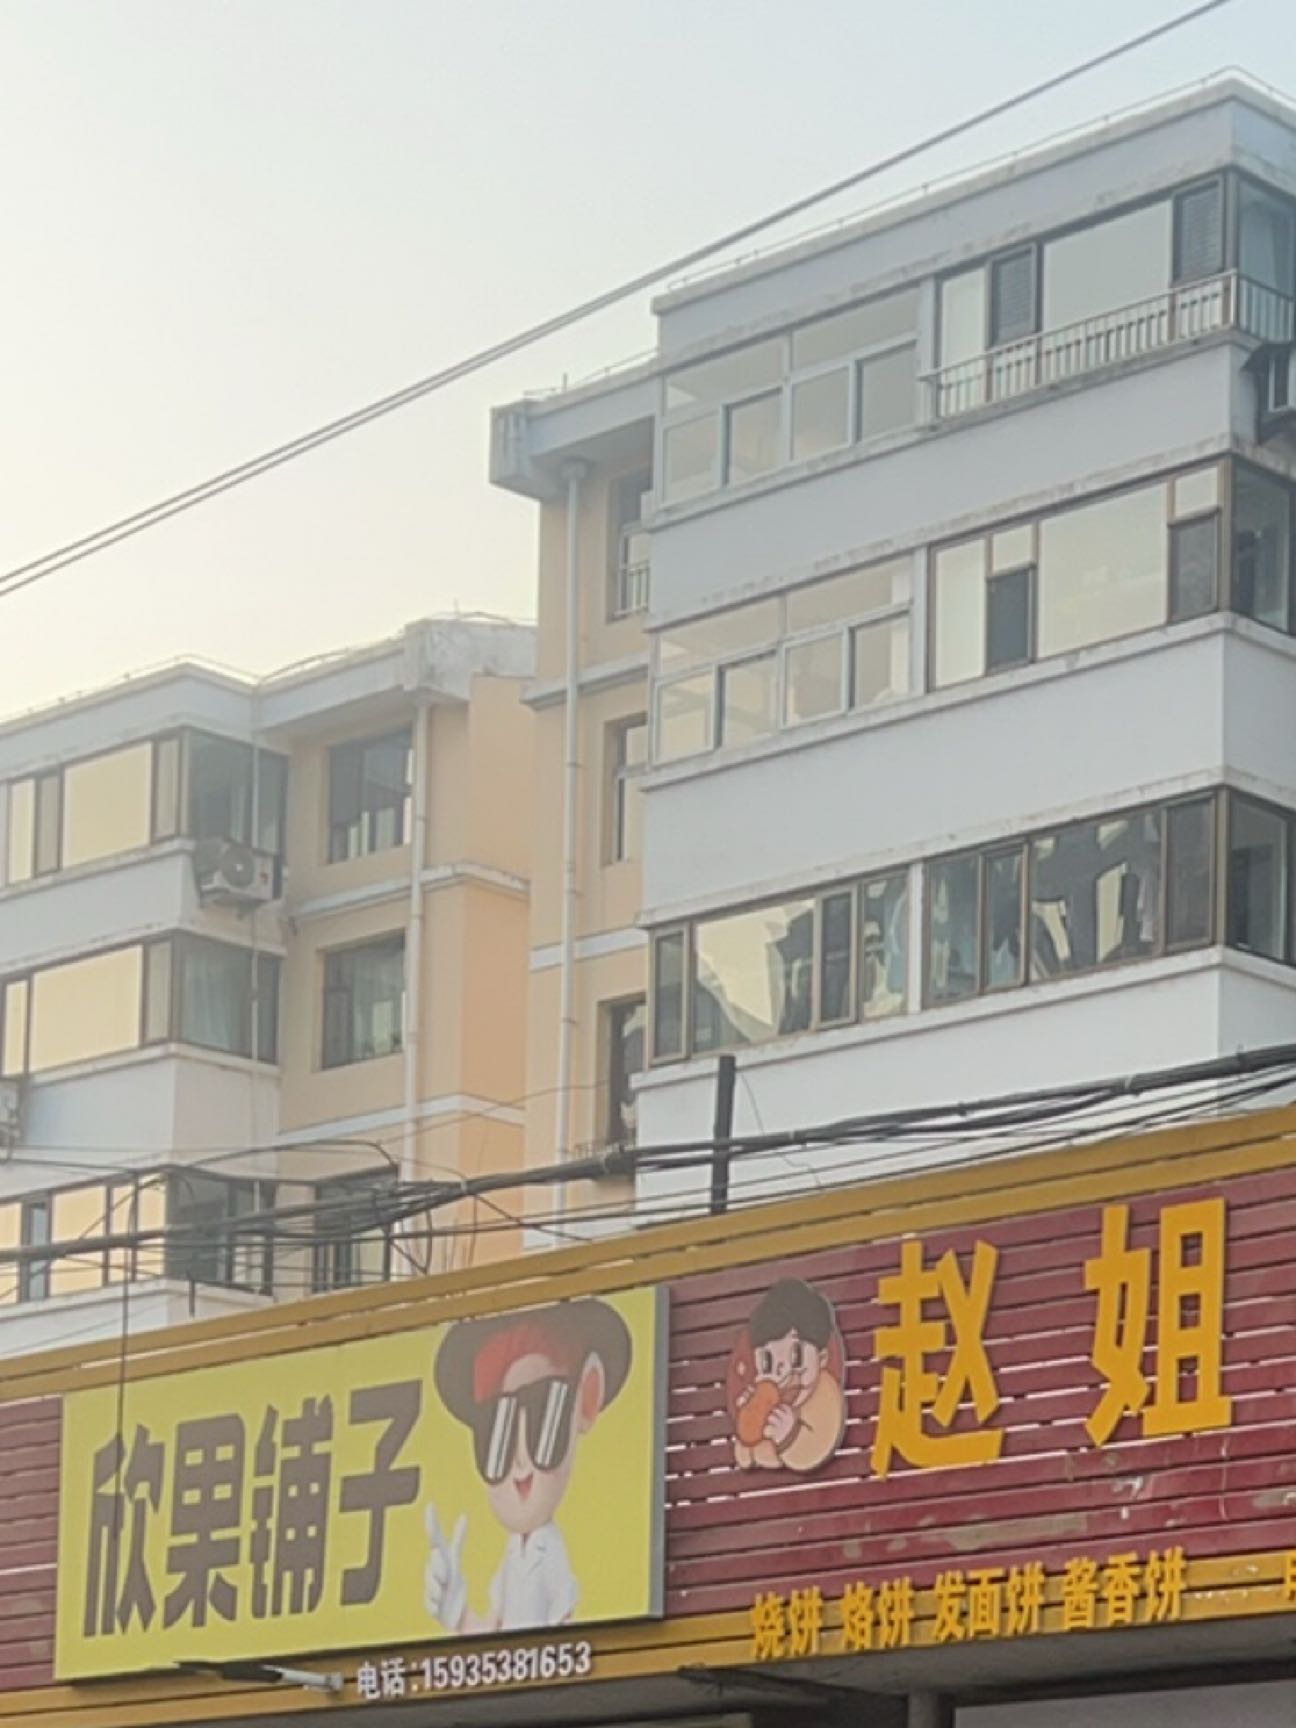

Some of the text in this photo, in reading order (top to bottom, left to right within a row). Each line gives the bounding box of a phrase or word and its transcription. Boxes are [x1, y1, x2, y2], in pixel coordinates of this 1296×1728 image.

[83, 1379, 423, 1637] 欣果铺子
[750, 1545, 1189, 1661] 烧饼 烙饼 发面饼 酱香饼
